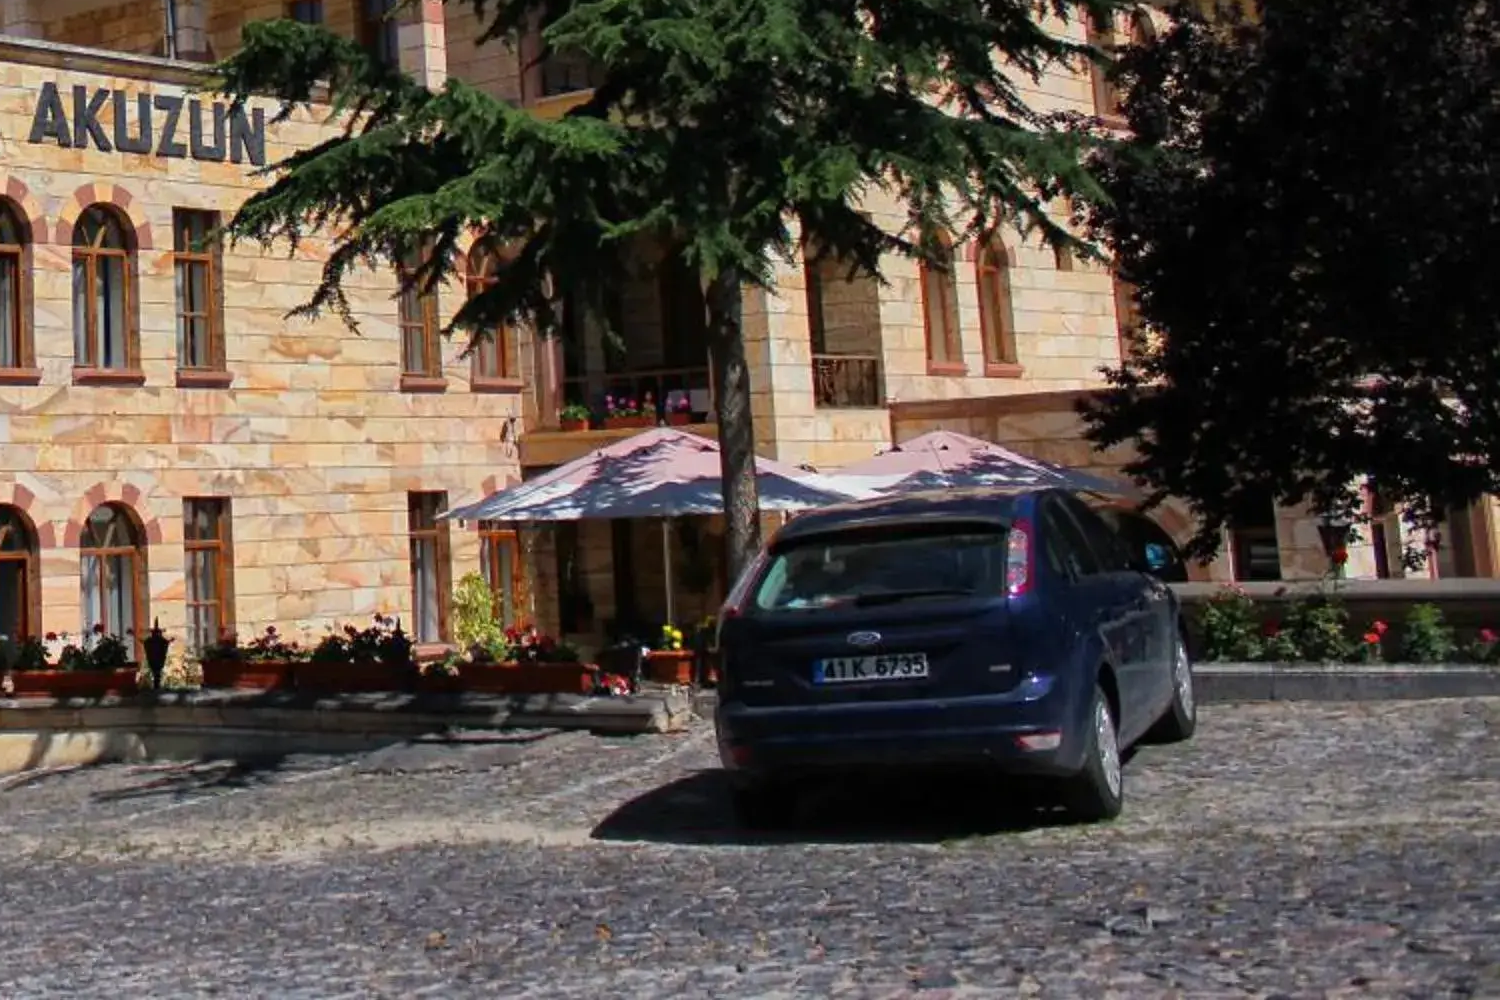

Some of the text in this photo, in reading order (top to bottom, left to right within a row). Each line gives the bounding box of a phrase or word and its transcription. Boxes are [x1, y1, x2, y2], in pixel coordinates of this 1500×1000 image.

[27, 80, 266, 166] AKUZUN
[824, 658, 846, 679] 41
[852, 657, 865, 678] K
